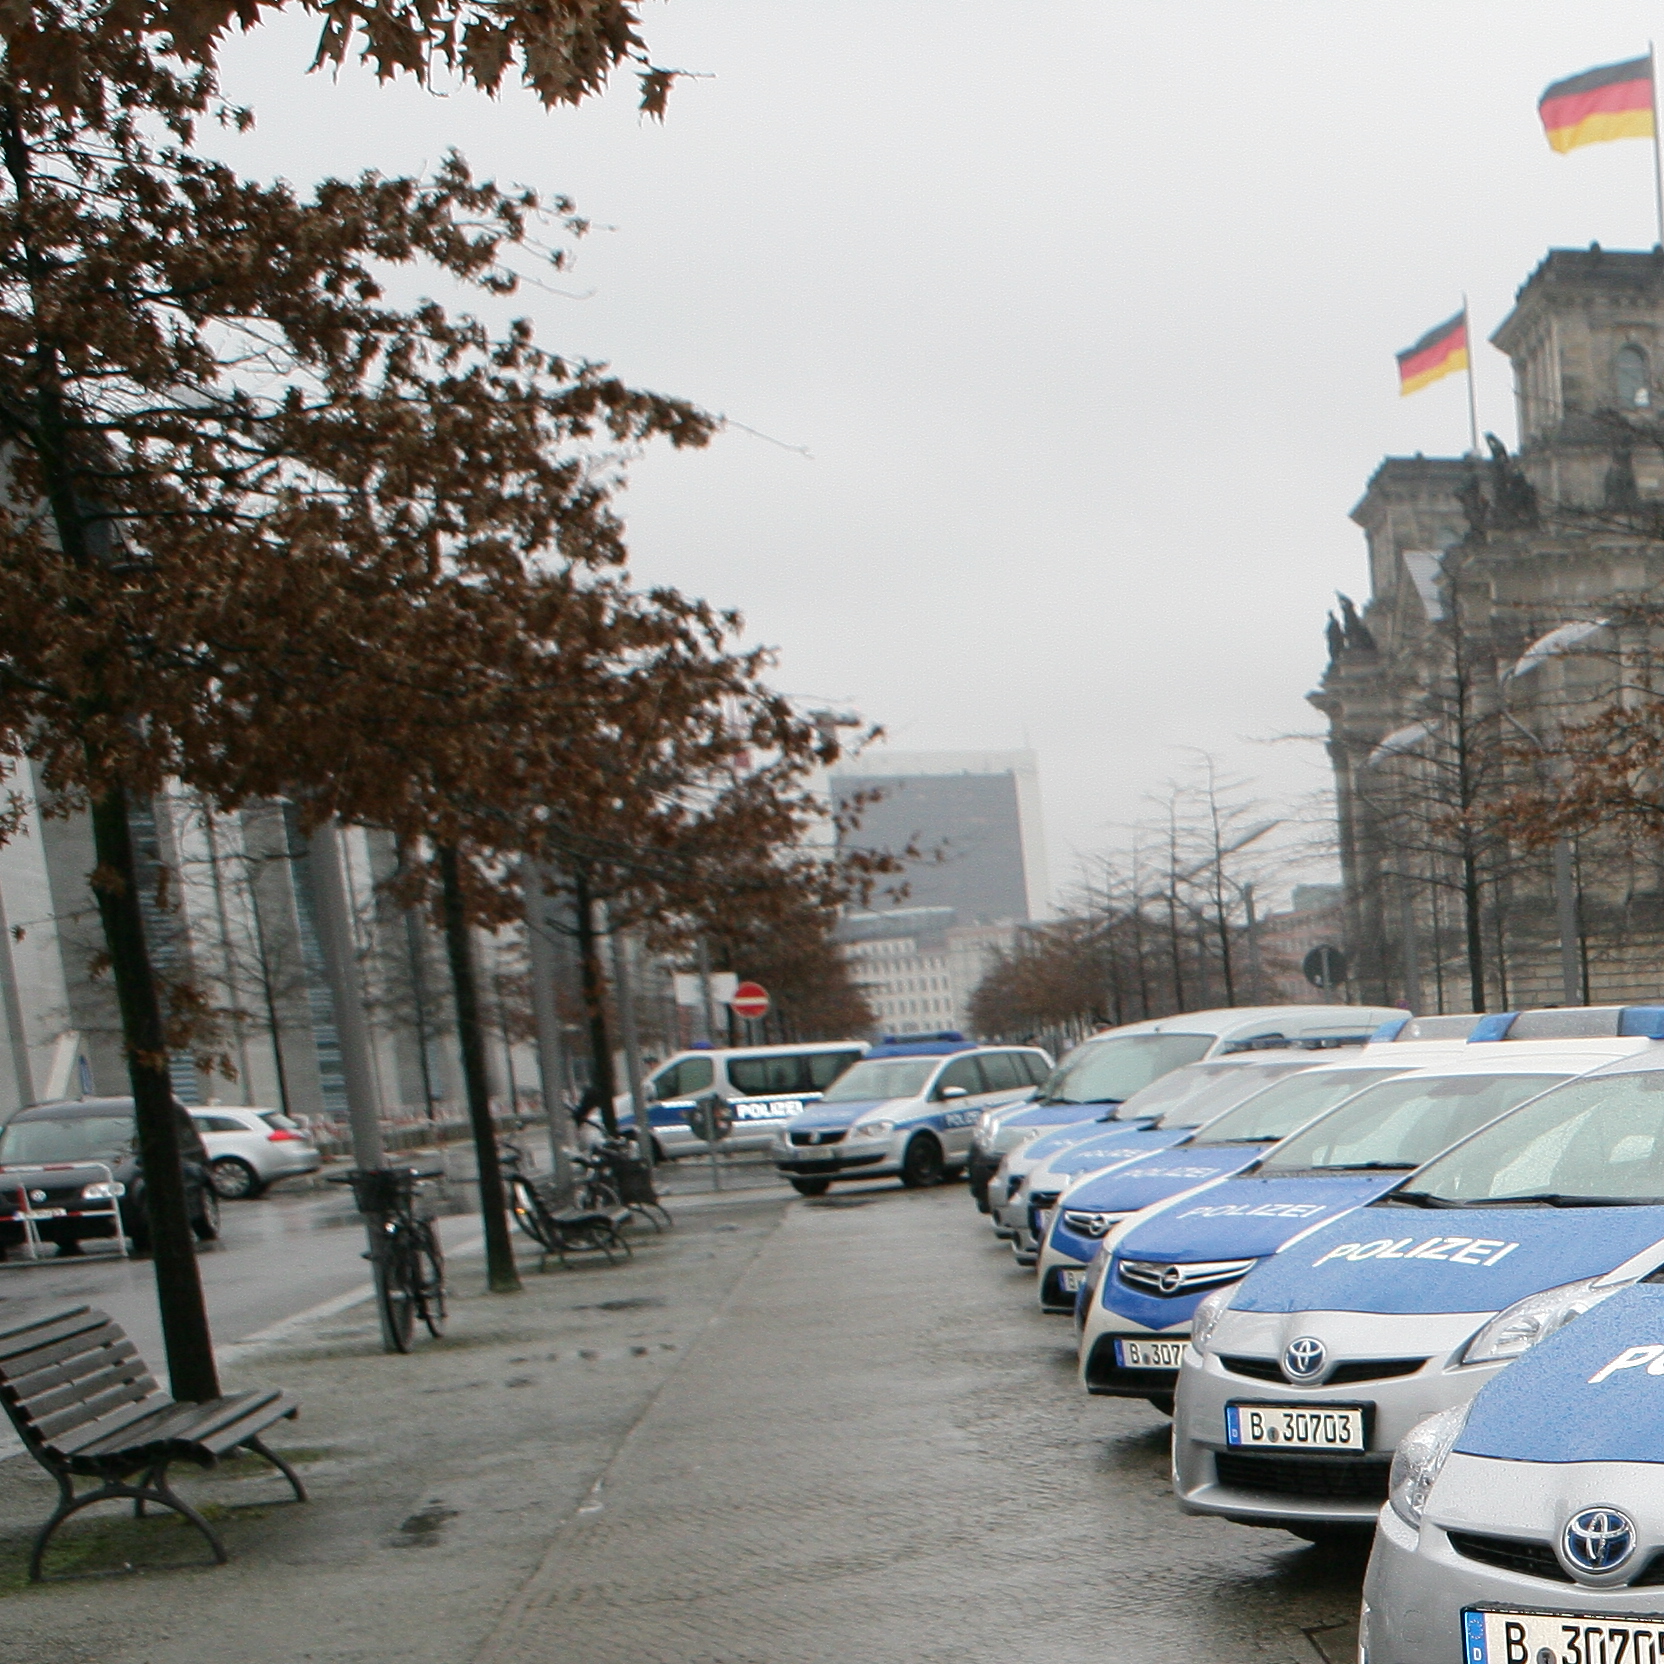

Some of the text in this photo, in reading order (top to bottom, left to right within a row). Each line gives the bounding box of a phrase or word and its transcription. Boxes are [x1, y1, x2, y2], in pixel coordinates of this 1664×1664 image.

[737, 1101, 803, 1119] POLIZEI
[1113, 1167, 1221, 1180] POLIZEI
[1176, 1204, 1326, 1219] POLIZEI
[1313, 1238, 1519, 1268] POLIZEI
[1130, 1342, 1187, 1365] B 307
[1251, 1412, 1264, 1440] B
[1283, 1413, 1351, 1443] 30703
[1473, 1648, 1482, 1661] D
